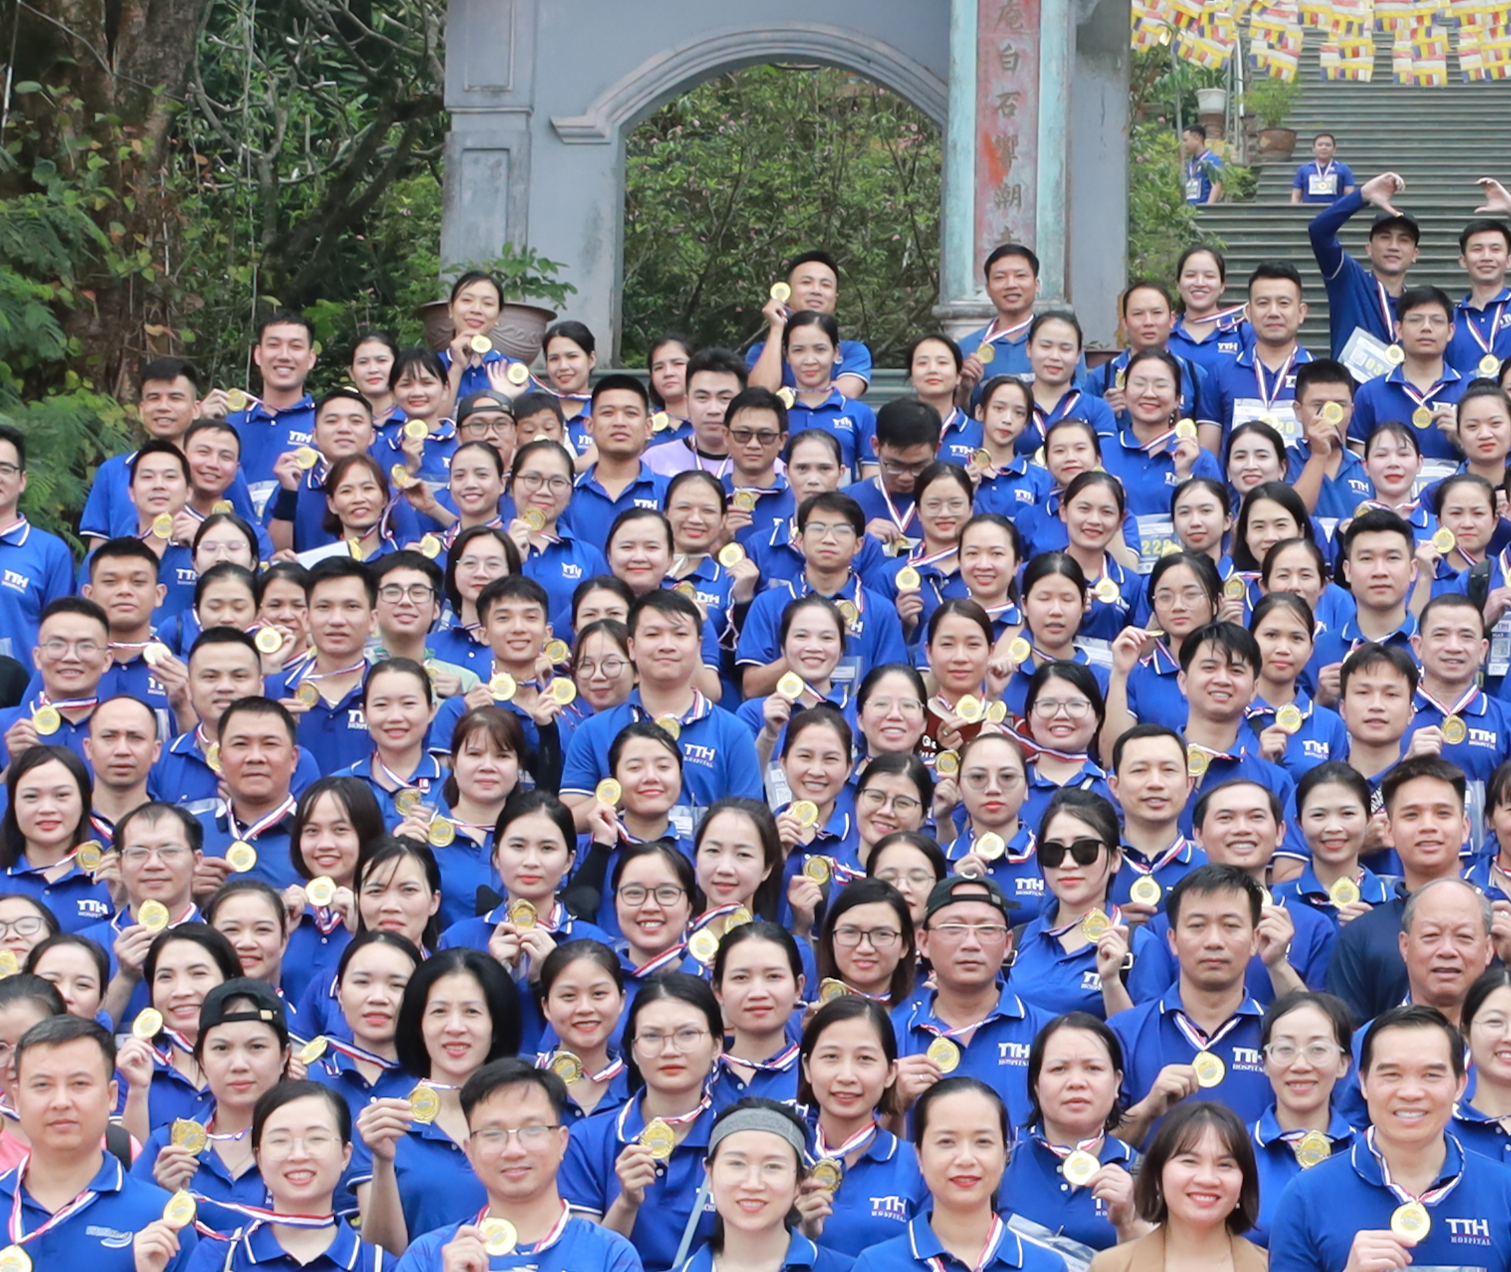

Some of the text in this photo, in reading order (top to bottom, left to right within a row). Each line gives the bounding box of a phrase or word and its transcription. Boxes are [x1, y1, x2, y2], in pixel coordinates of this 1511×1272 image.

[1218, 343, 1238, 351] TTH
[289, 430, 312, 443] TTH
[1348, 480, 1369, 493] TTH
[4, 570, 29, 588] TTH
[1468, 728, 1496, 743] TTH
[685, 744, 715, 761] TTH
[1303, 740, 1329, 754] TTH
[1015, 878, 1044, 890] TTH
[77, 899, 108, 913] TTH
[998, 1043, 1030, 1058] TTH
[869, 1196, 907, 1213] TTH
[871, 1211, 907, 1222] HOSPITAL
[1445, 1218, 1489, 1236] TTH
[1451, 1237, 1491, 1245] HOSPITAL
